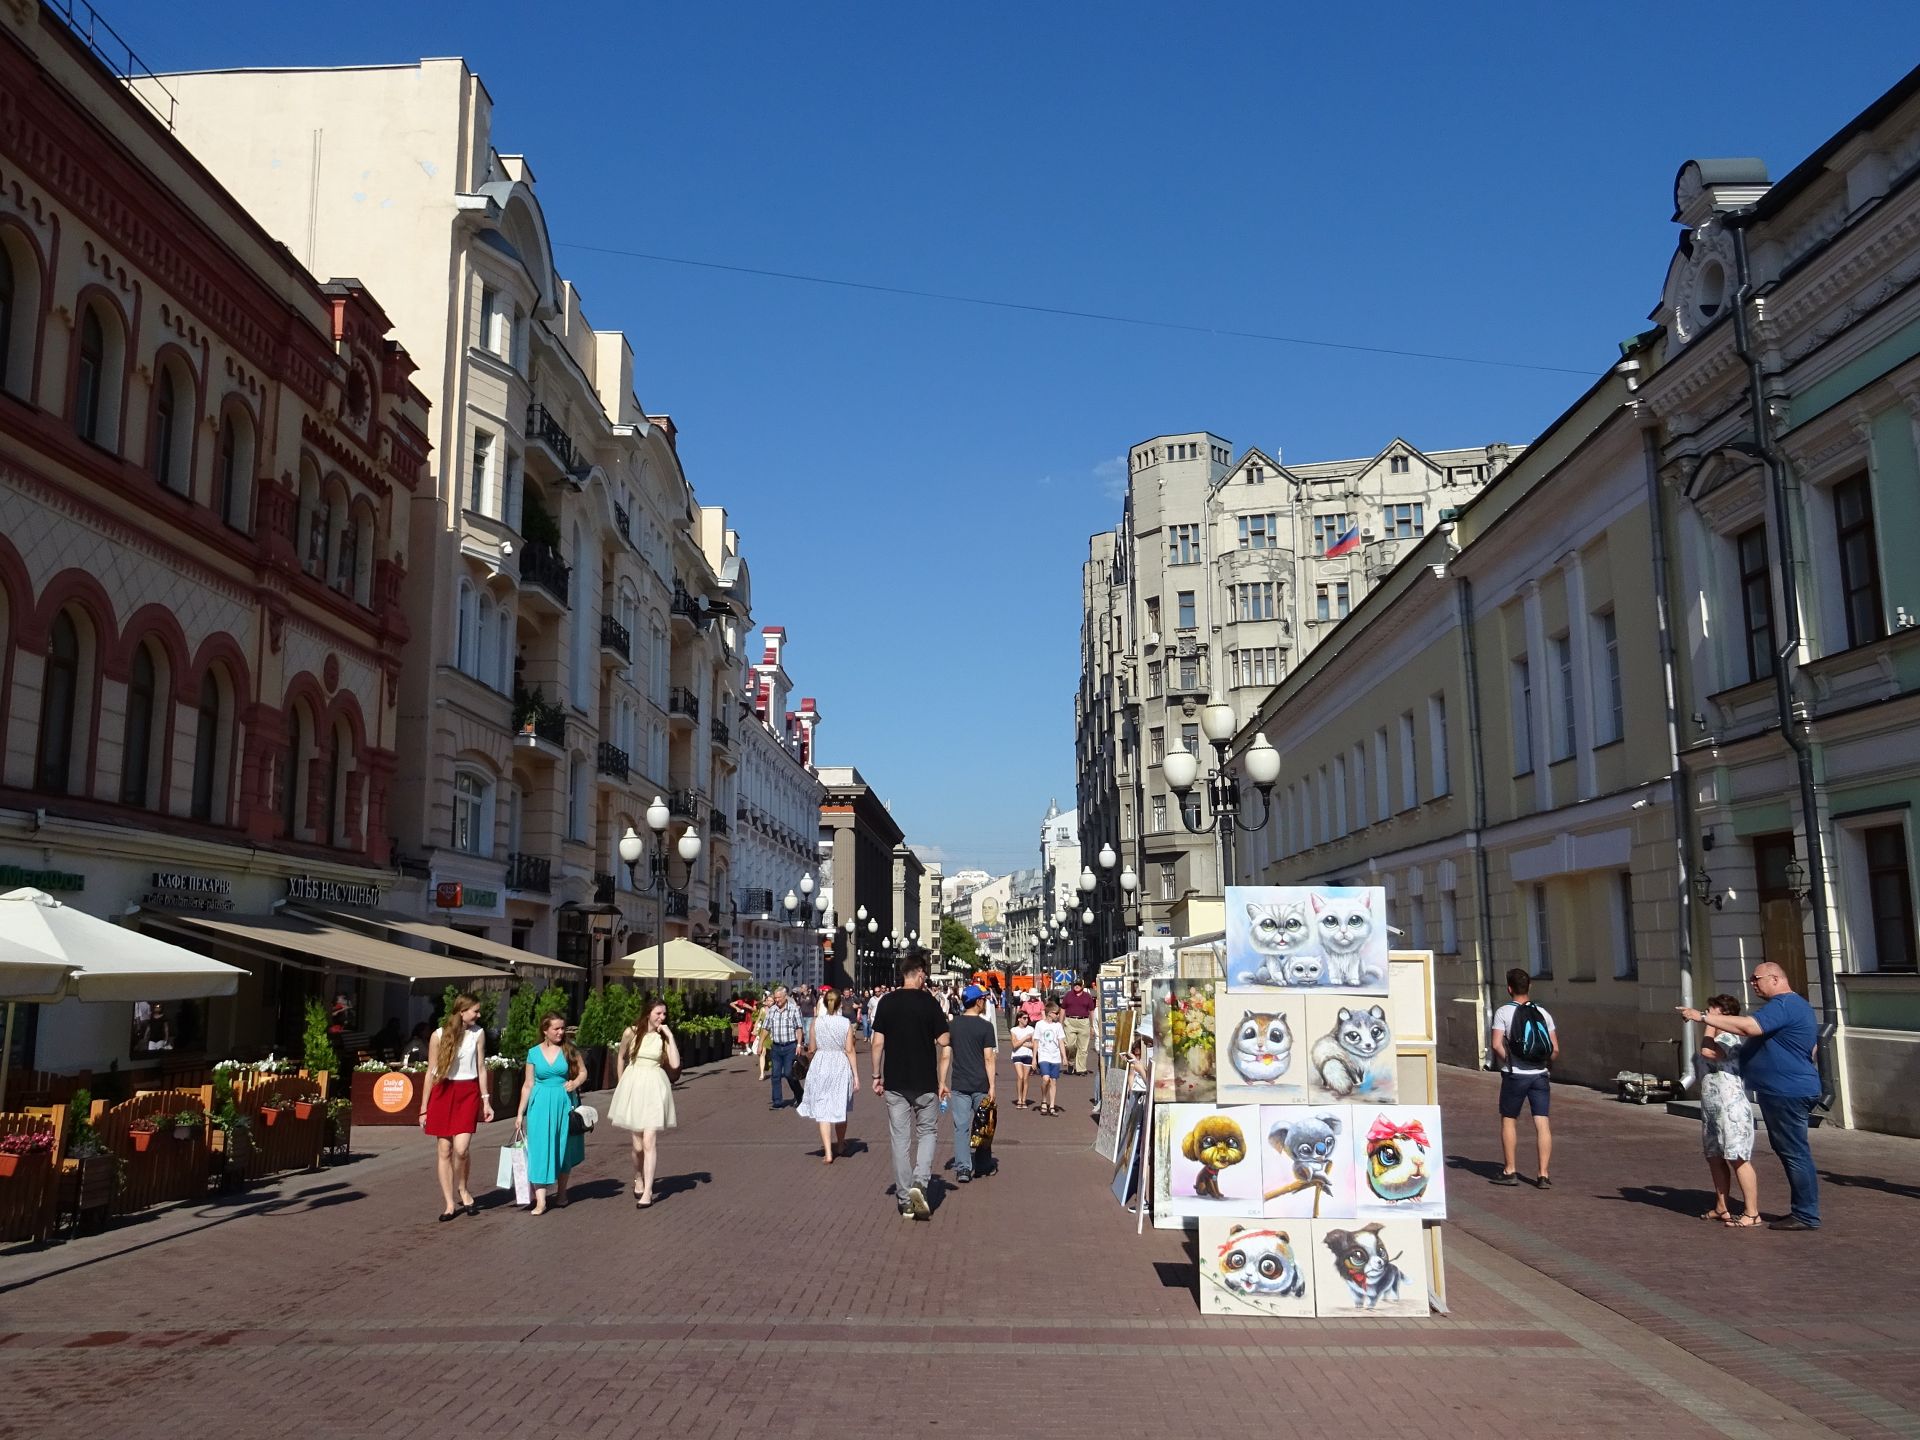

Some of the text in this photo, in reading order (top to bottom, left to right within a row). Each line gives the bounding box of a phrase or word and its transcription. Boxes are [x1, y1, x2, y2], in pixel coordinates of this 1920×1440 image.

[158, 873, 232, 894] КАФЕ ПЕКАРНЯ
[321, 881, 382, 906] НАСУЩНЫЙ
